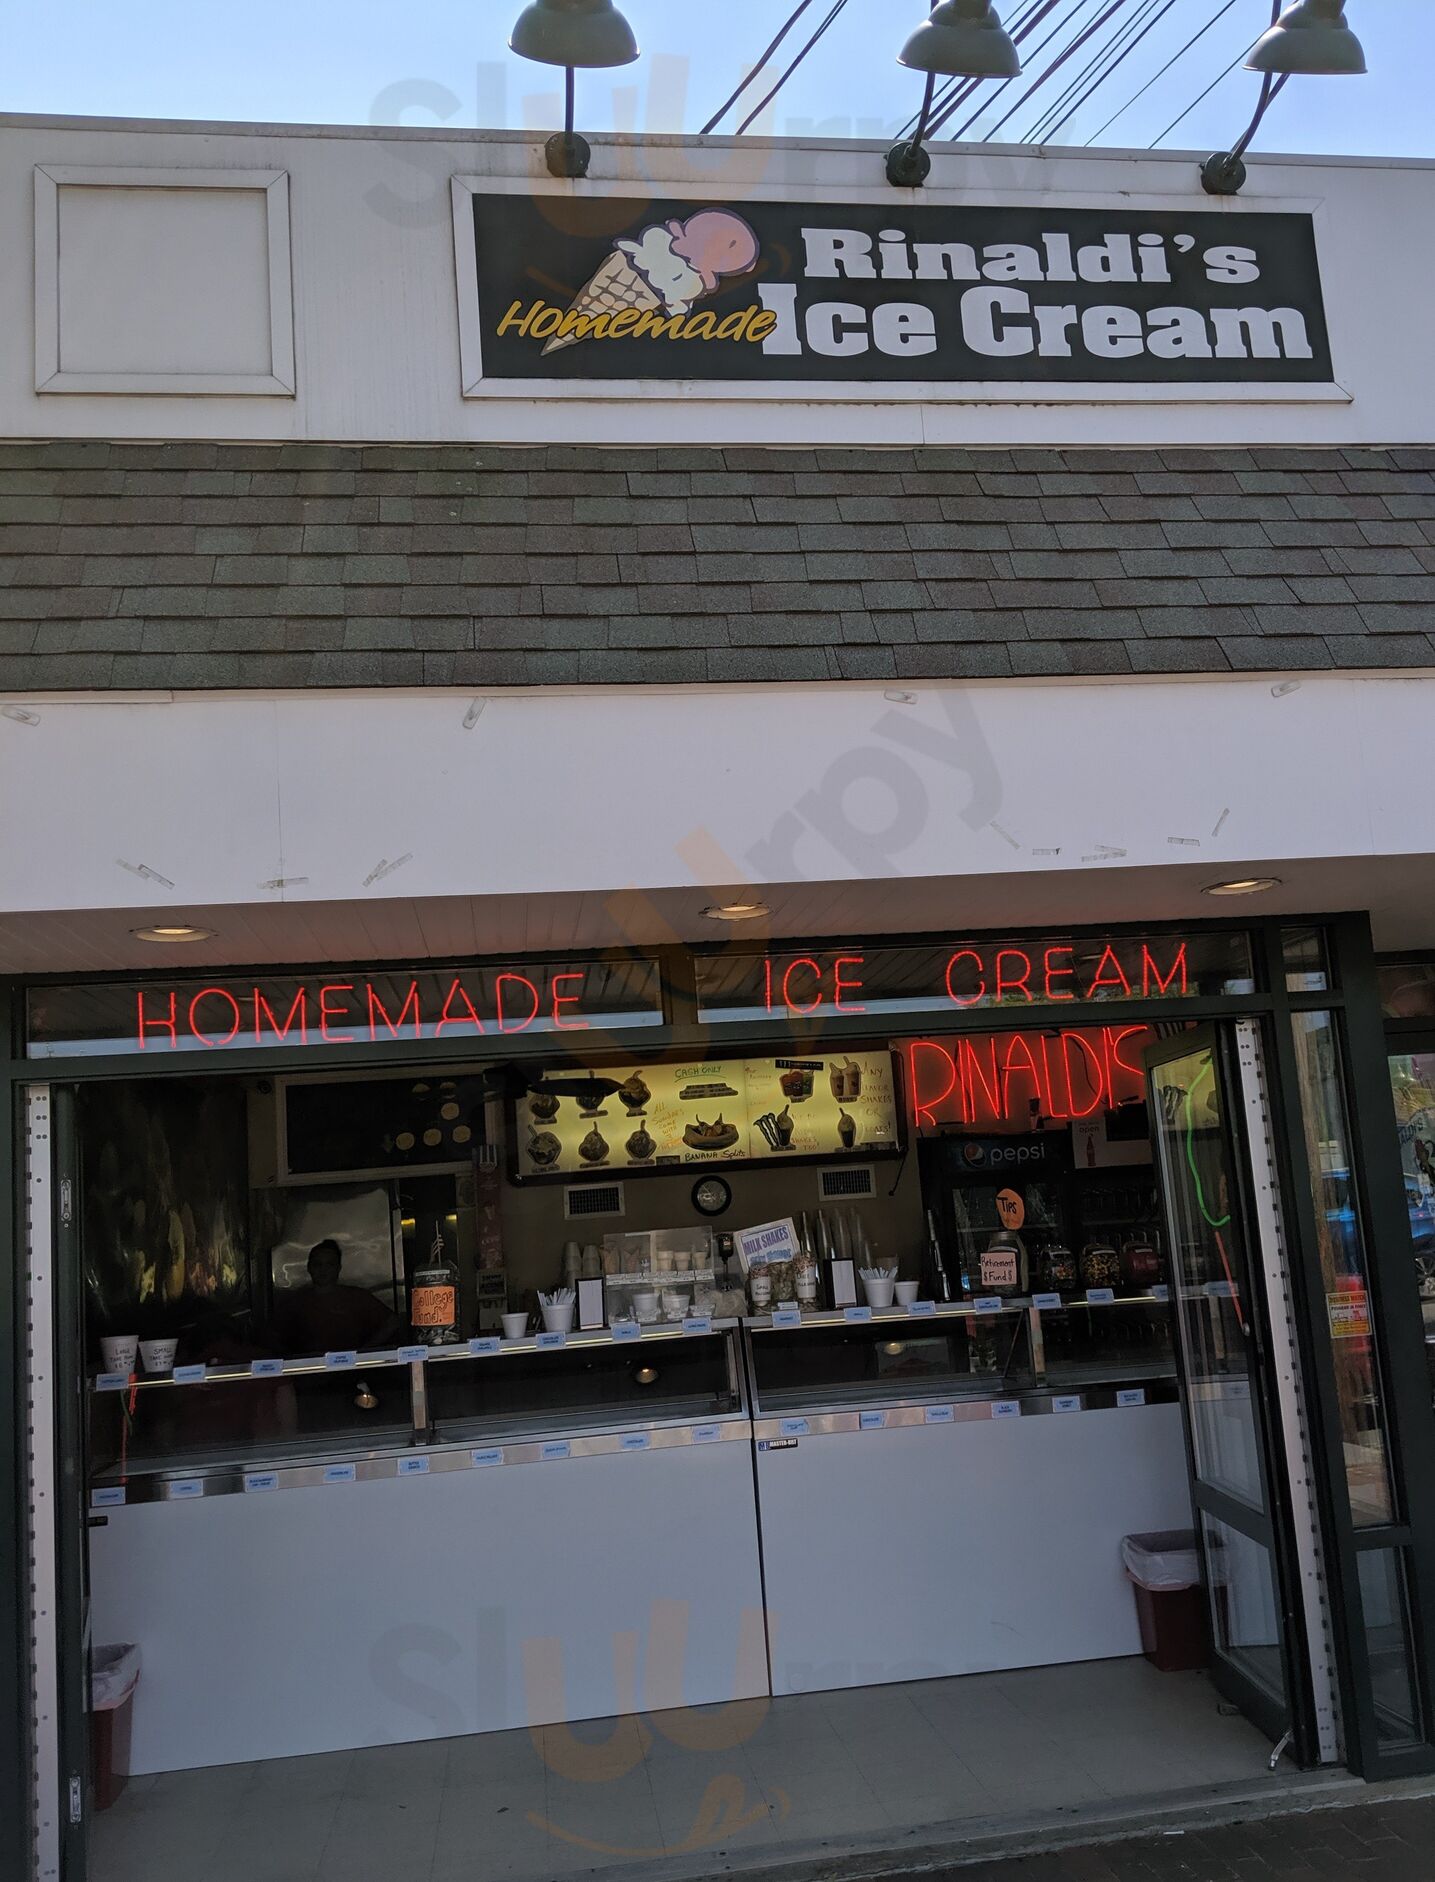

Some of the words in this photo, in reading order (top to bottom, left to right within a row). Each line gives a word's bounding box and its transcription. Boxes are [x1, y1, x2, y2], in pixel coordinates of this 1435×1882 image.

[801, 227, 1260, 284] Rinaldi's
[495, 299, 778, 343] Homemade
[757, 283, 938, 358] Ice
[959, 285, 1314, 360] Cream
[765, 957, 866, 1013] ICE
[945, 943, 1187, 1005] CREAM
[138, 973, 589, 1048] HOMEMADE
[684, 1152, 718, 1162] BANANA
[989, 1142, 1046, 1166] pepsi
[743, 1237, 763, 1255] MILK
[760, 1226, 789, 1248] SHAKES
[981, 1256, 1015, 1268] Retirement
